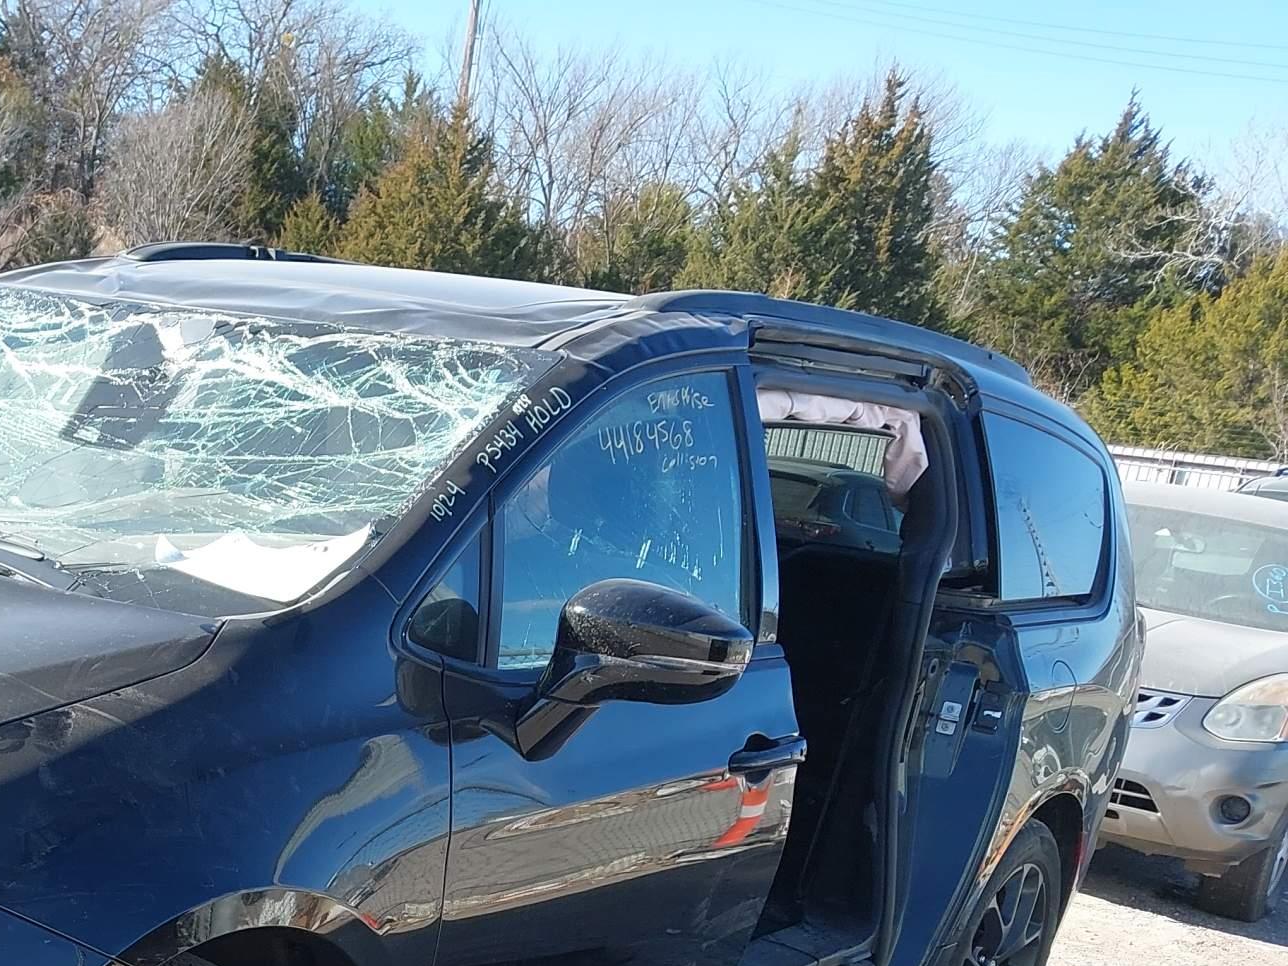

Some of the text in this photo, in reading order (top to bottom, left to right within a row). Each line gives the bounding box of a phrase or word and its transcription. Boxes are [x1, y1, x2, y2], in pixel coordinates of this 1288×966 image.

[430, 479, 467, 522] 10/24
[524, 386, 572, 435] HOLD
[597, 419, 694, 465] 44184568
